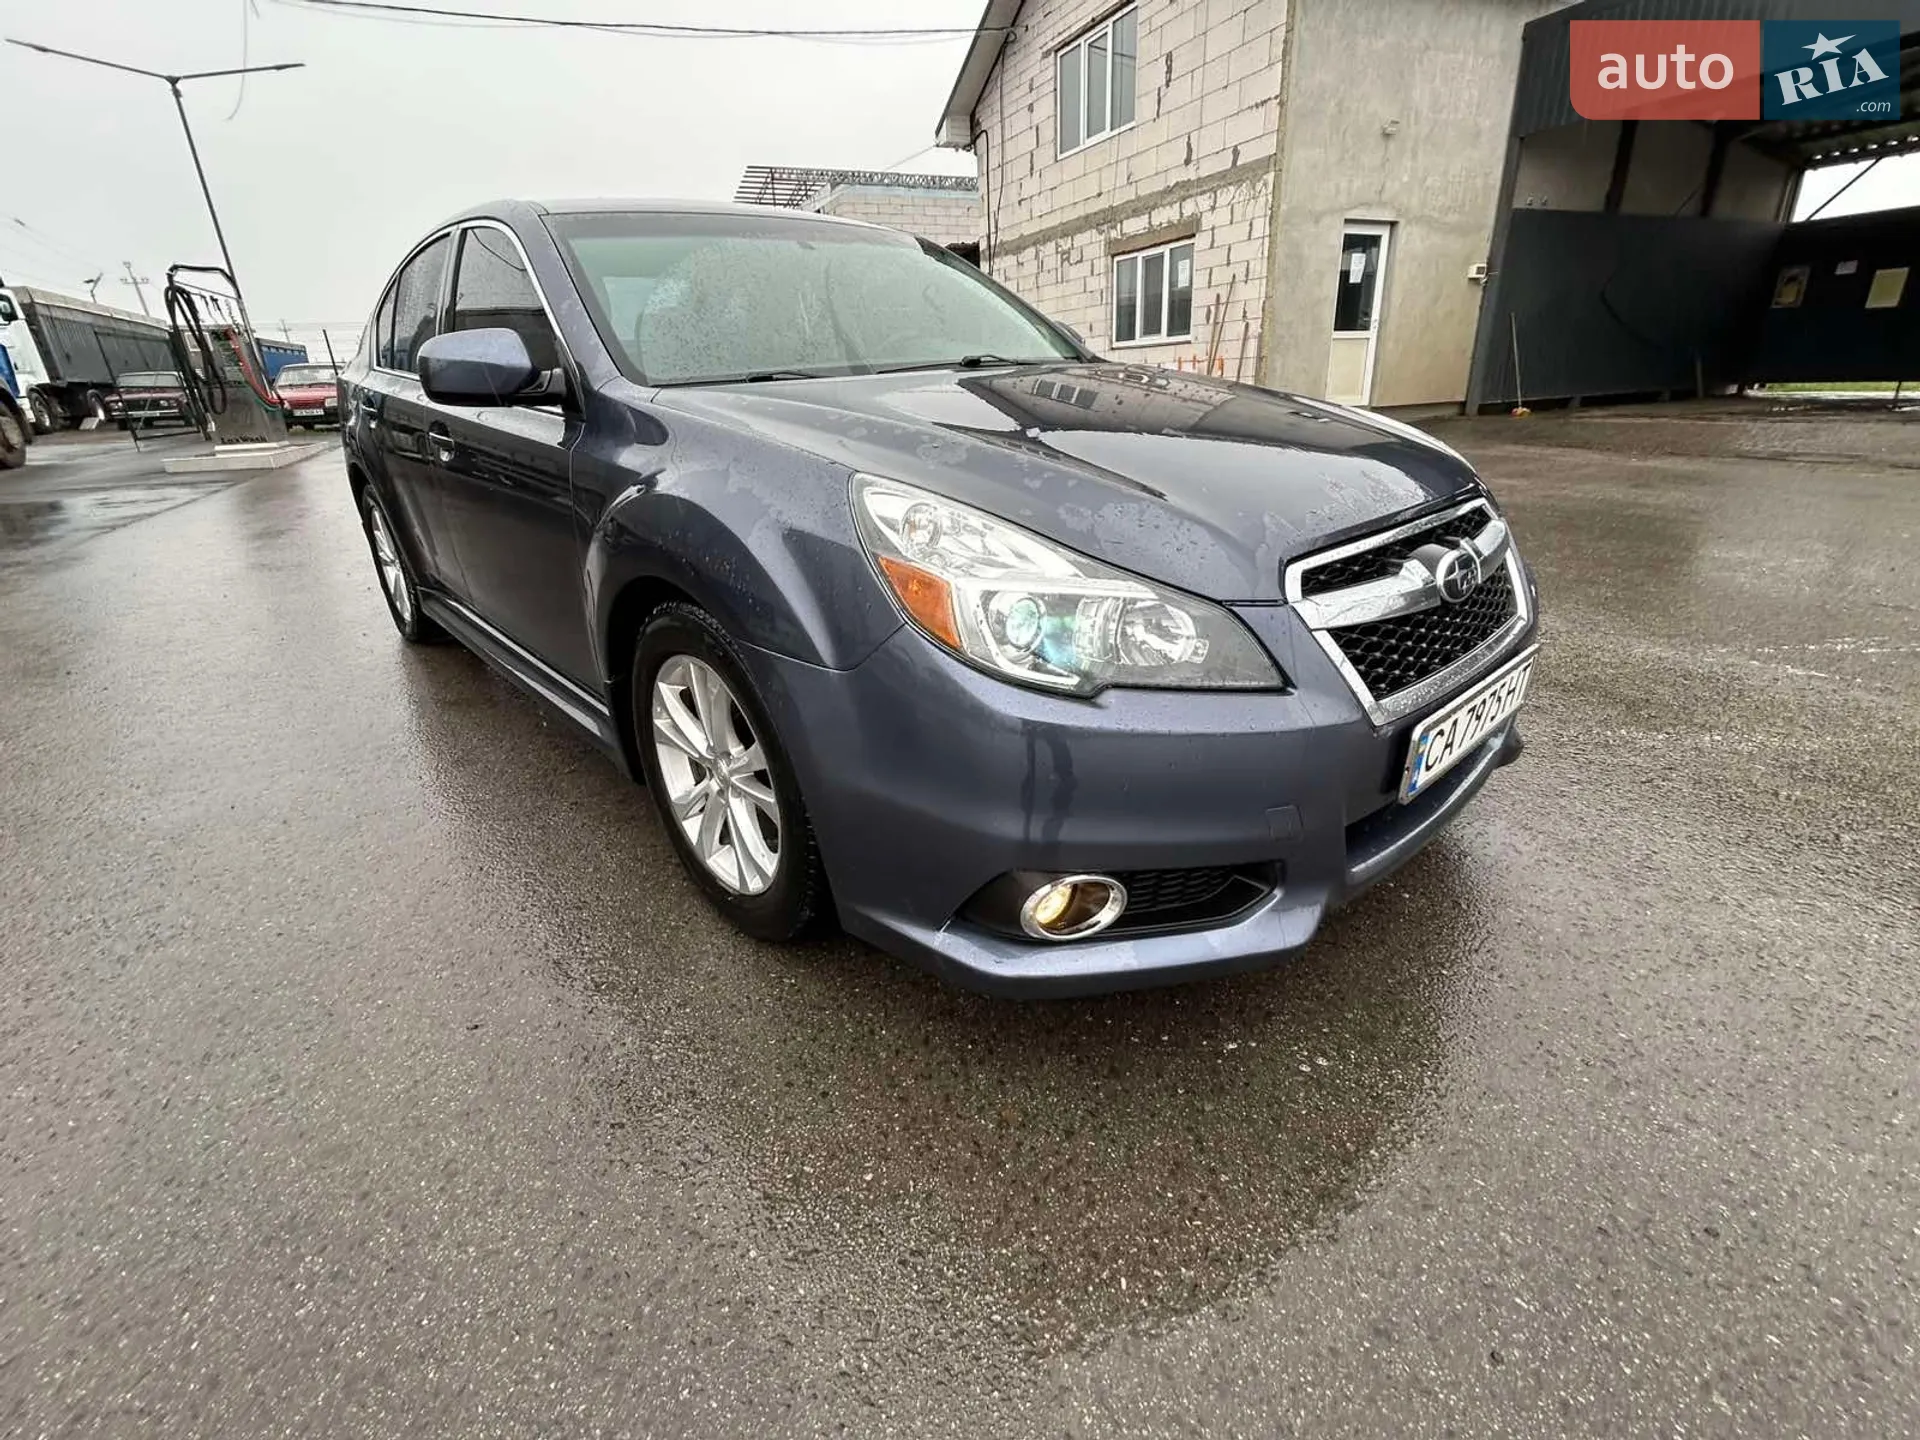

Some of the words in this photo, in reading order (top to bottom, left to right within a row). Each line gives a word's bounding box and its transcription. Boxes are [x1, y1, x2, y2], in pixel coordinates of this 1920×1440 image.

[1425, 717, 1459, 772] CA
[1458, 683, 1506, 748] 7975
[1501, 662, 1533, 714] HT
